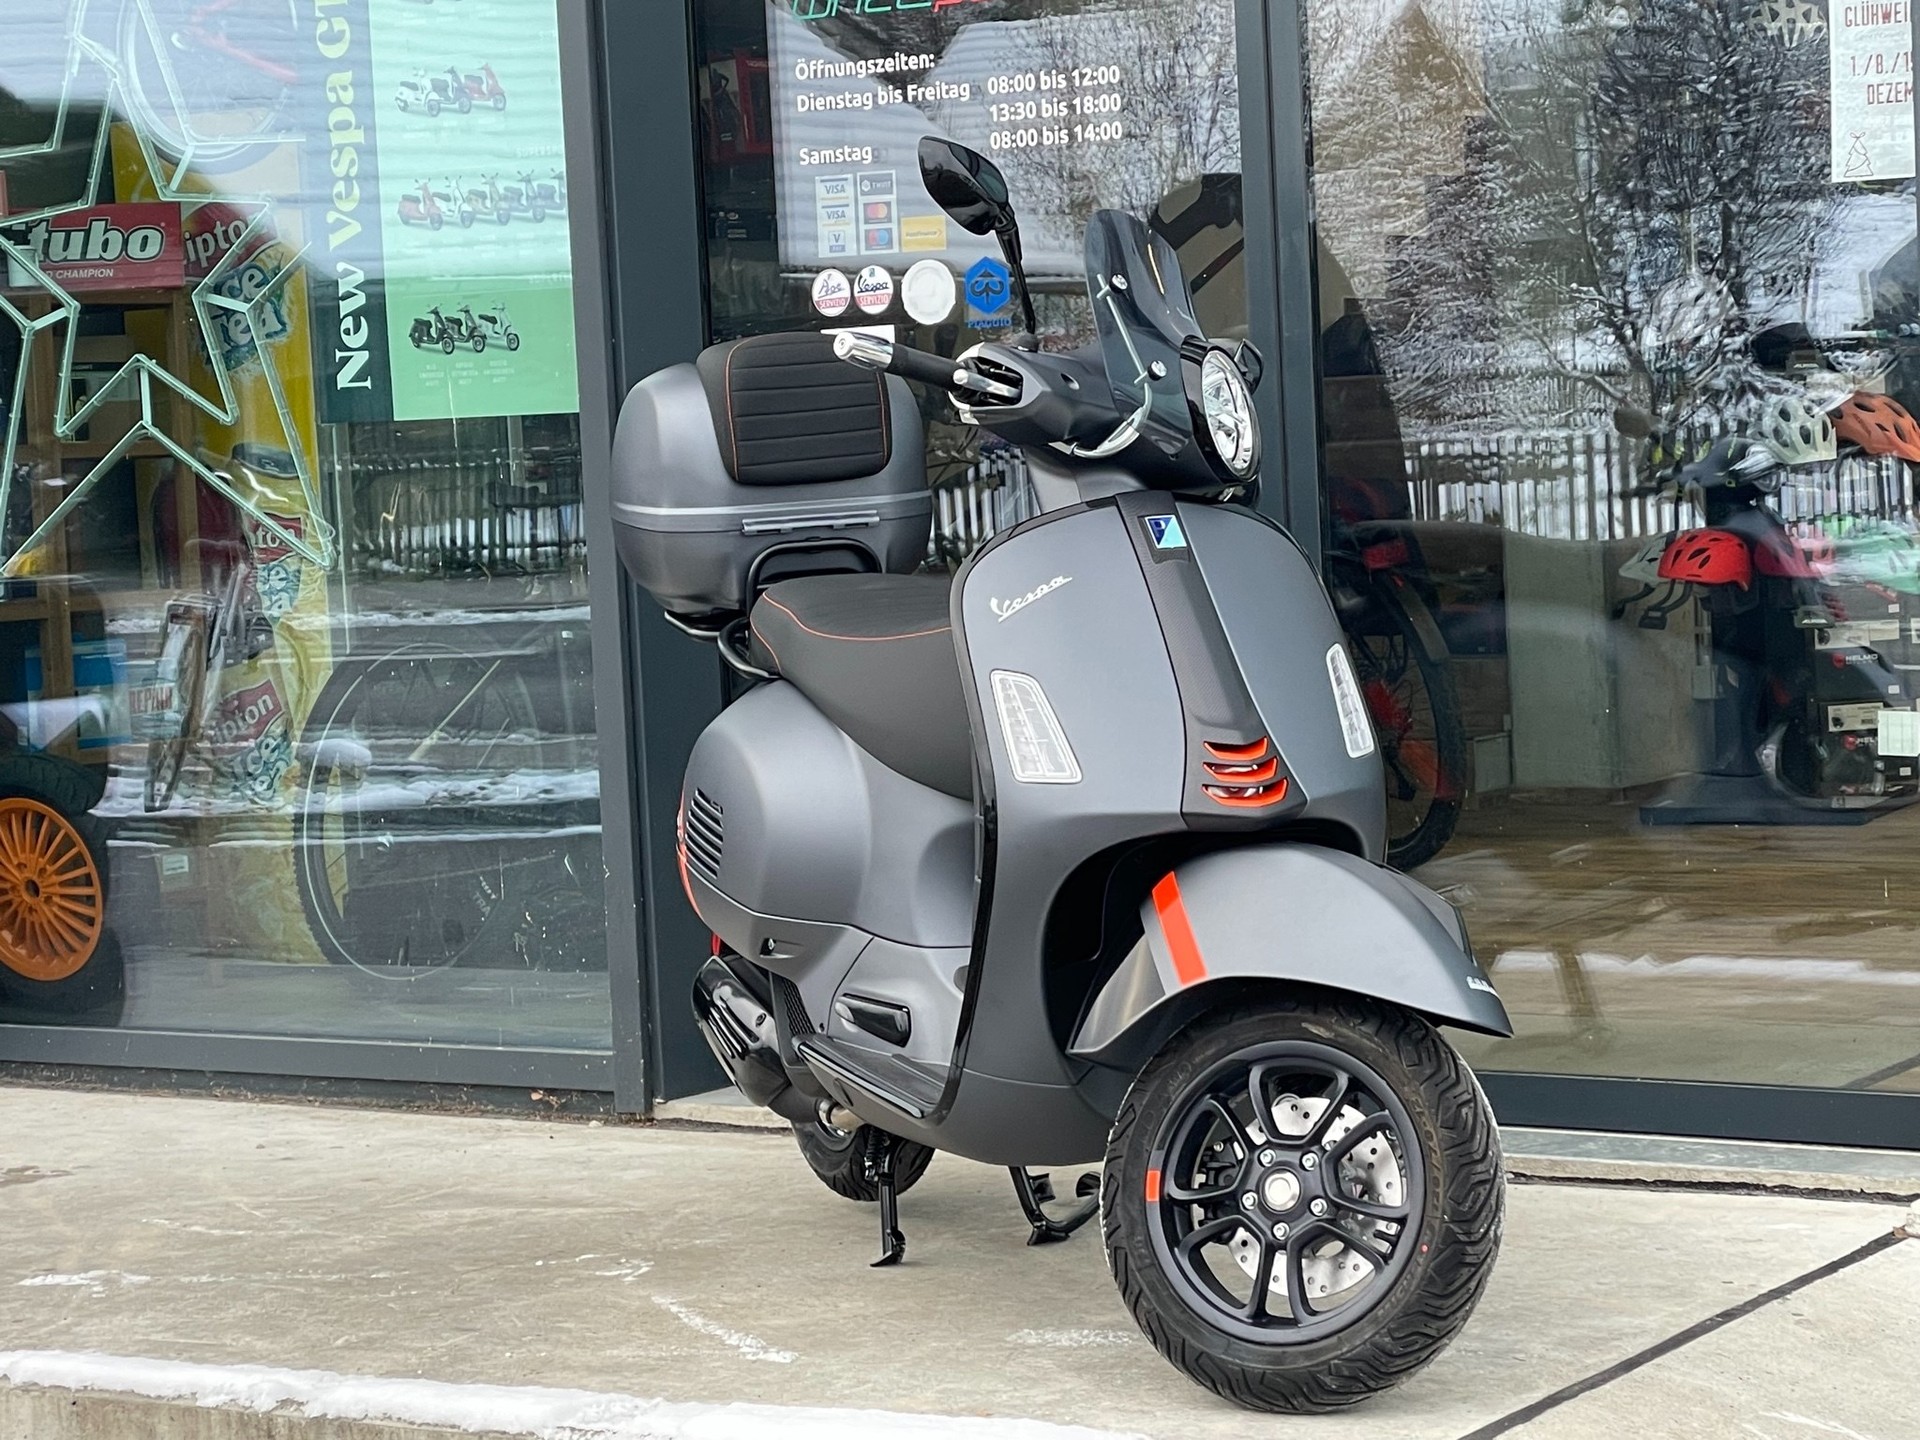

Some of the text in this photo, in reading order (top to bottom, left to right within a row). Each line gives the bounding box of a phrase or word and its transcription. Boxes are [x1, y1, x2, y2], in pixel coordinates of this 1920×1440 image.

[795, 51, 936, 81] Öffnungszeiten:
[987, 64, 1120, 95] 08:00 bis 12:00
[796, 80, 971, 113] Dienstag bis Freitag
[989, 92, 1122, 122] 13:30 bis 18:00
[989, 120, 1122, 150] 08:00 bis 14:00
[325, 70, 366, 252] Vespa
[799, 144, 873, 166] Samstag
[824, 183, 846, 195] VISA
[826, 209, 847, 220] VISA
[55, 268, 115, 279] CHAMPION
[857, 273, 890, 294] Vespa
[819, 299, 846, 310] SERVIZIO
[860, 295, 889, 307] SERVIZIO
[334, 261, 372, 391] New
[989, 575, 1074, 623] Vespa
